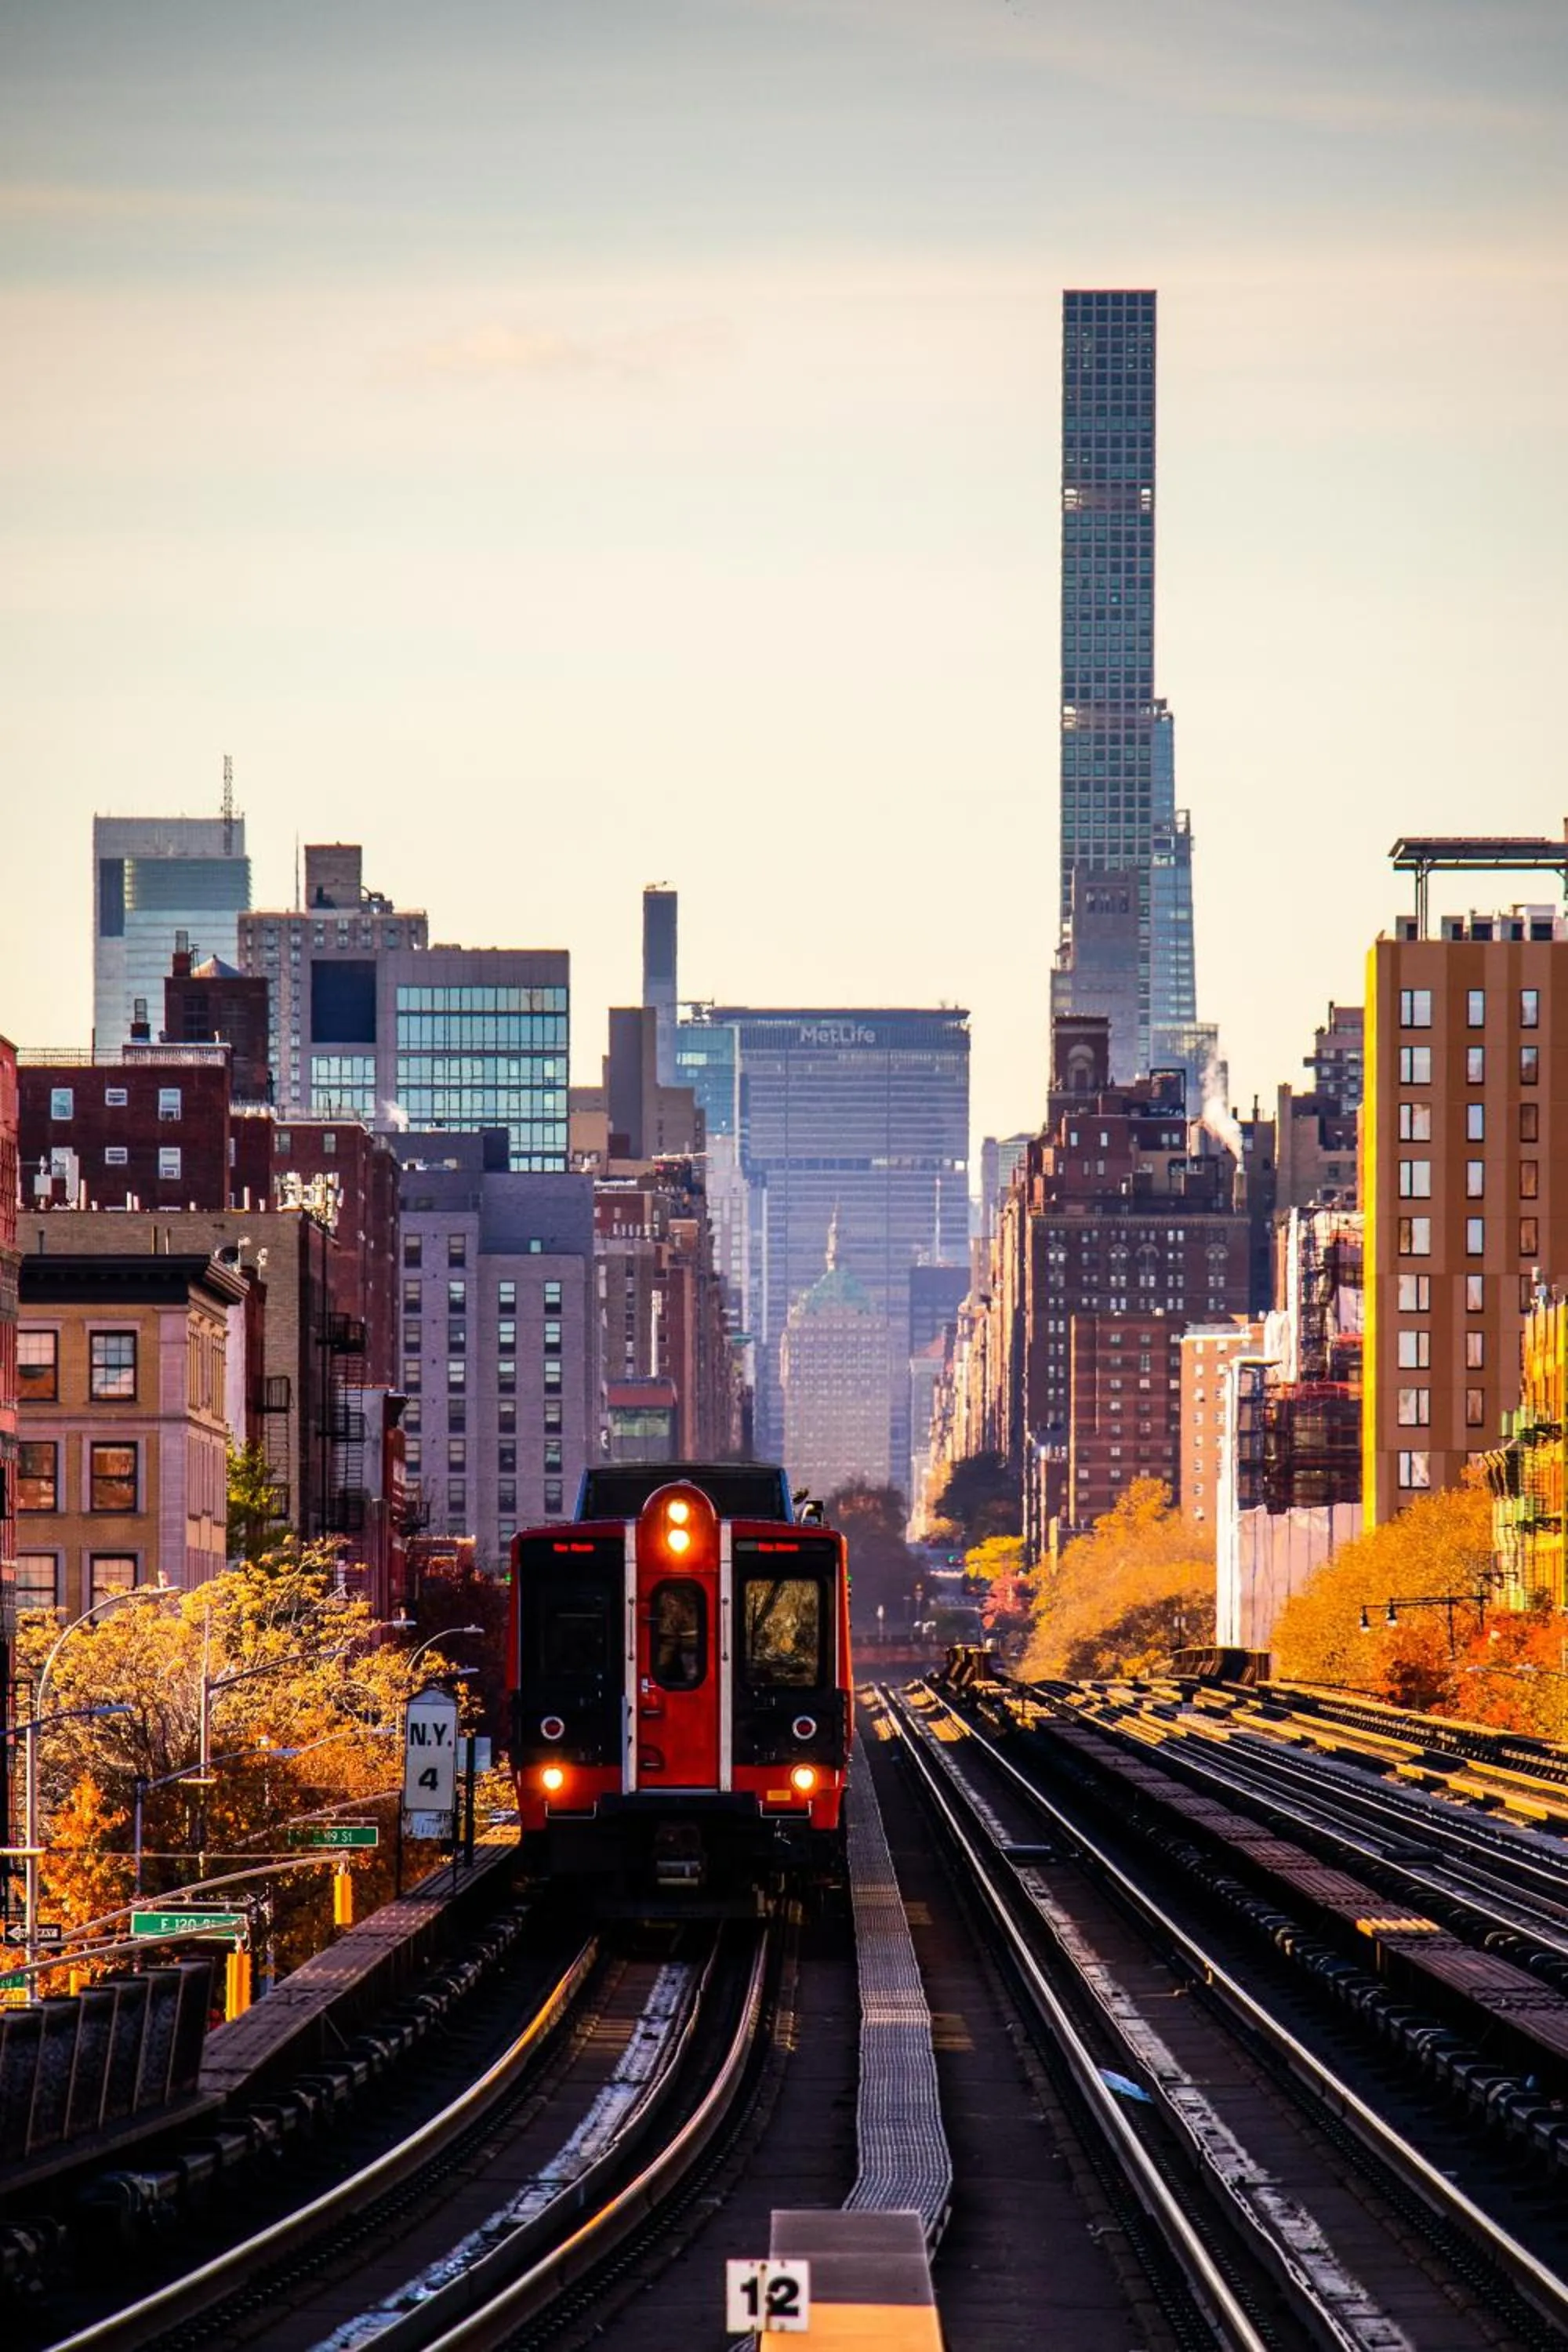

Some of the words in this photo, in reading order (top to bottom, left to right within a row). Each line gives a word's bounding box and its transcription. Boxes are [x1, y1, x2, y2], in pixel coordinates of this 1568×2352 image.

[800, 1025, 876, 1042] MetLife
[409, 1722, 452, 1747] N.Y.
[418, 1768, 438, 1791] 4
[341, 1831, 353, 1843] St
[175, 1918, 197, 1932] 120
[740, 2276, 800, 2317] 12
